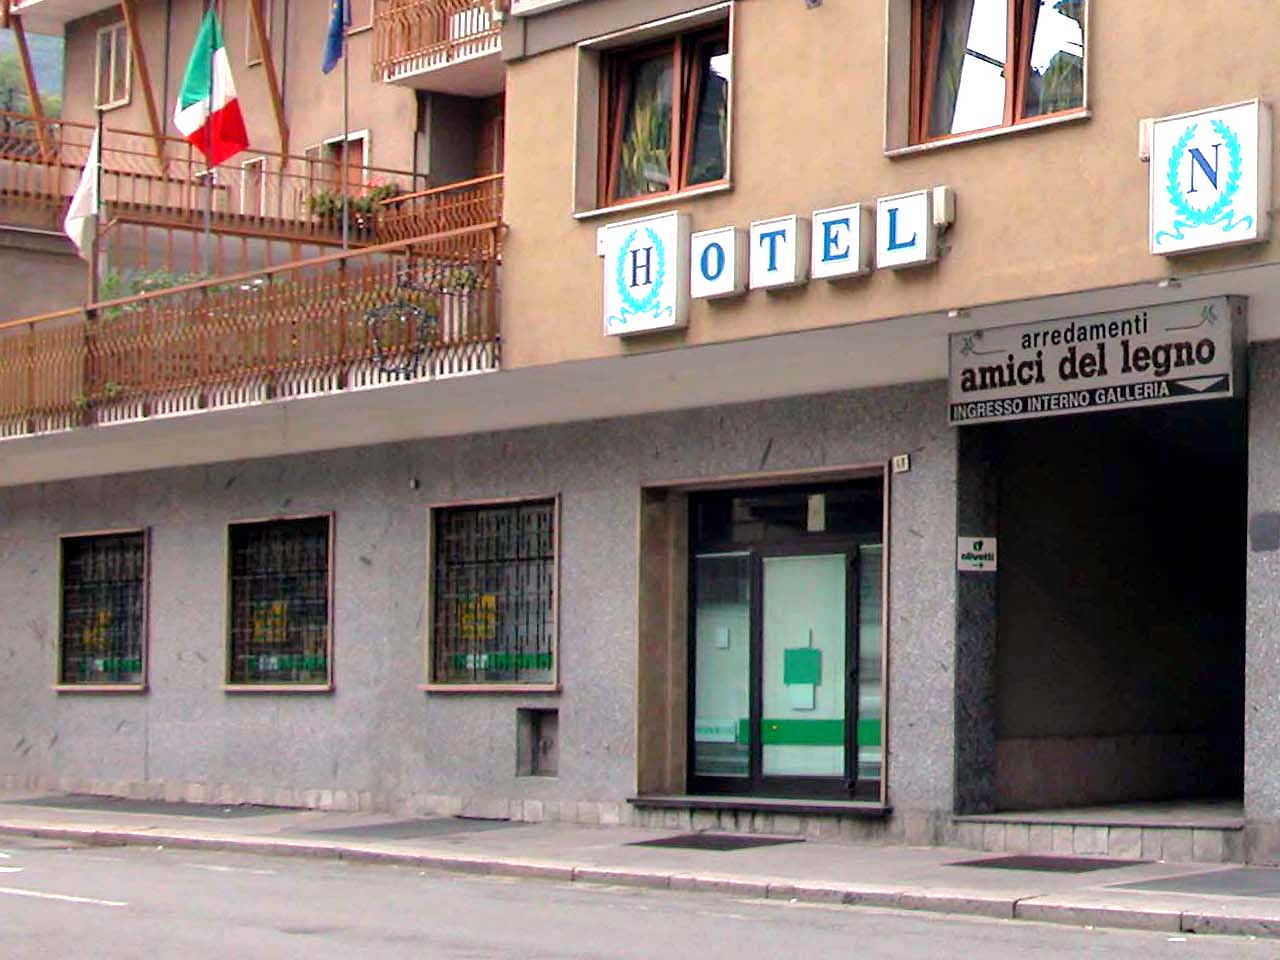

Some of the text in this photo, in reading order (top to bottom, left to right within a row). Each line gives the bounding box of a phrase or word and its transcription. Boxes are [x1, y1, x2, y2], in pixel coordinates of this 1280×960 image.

[631, 206, 918, 288] HOTEL
[1021, 312, 1148, 350] arredamenti
[960, 337, 1216, 393] amici del legno
[953, 381, 1170, 420] INGRESSO INTERNO GALLERIA
